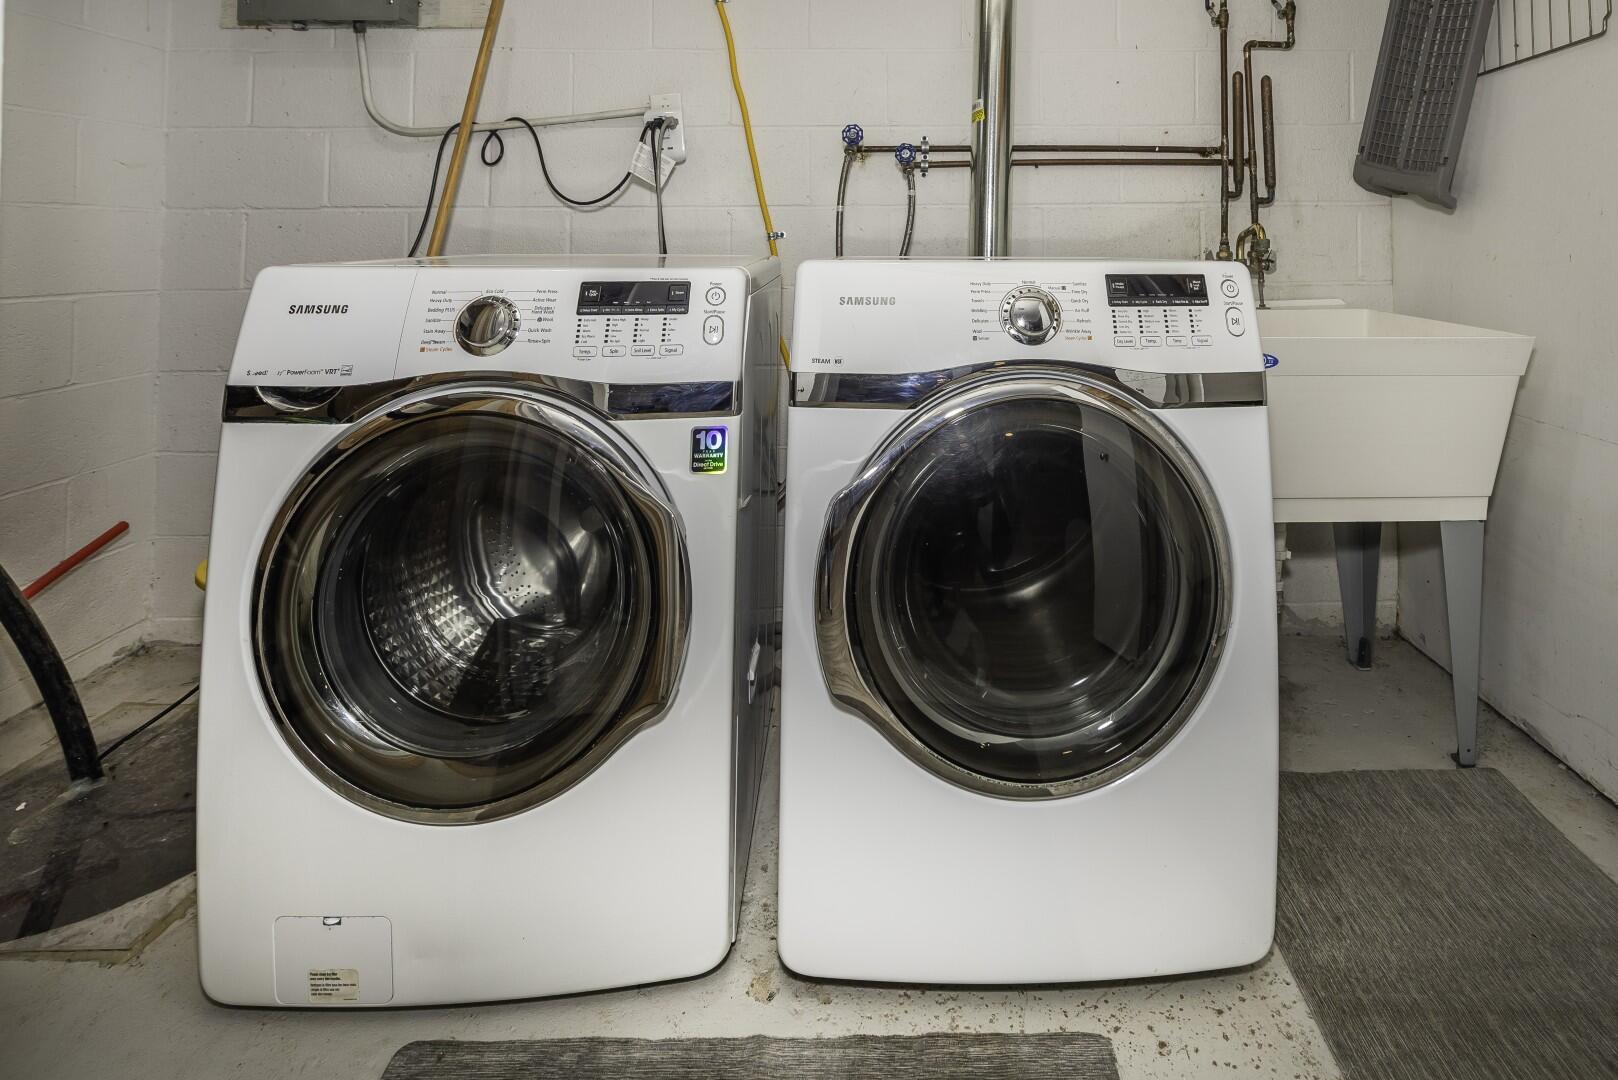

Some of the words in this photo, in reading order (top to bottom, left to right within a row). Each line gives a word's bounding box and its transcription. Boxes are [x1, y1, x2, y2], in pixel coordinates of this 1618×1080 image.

[839, 296, 896, 306] SAMSUNG
[288, 304, 349, 315] SAMSUNG
[695, 430, 723, 450] 10
